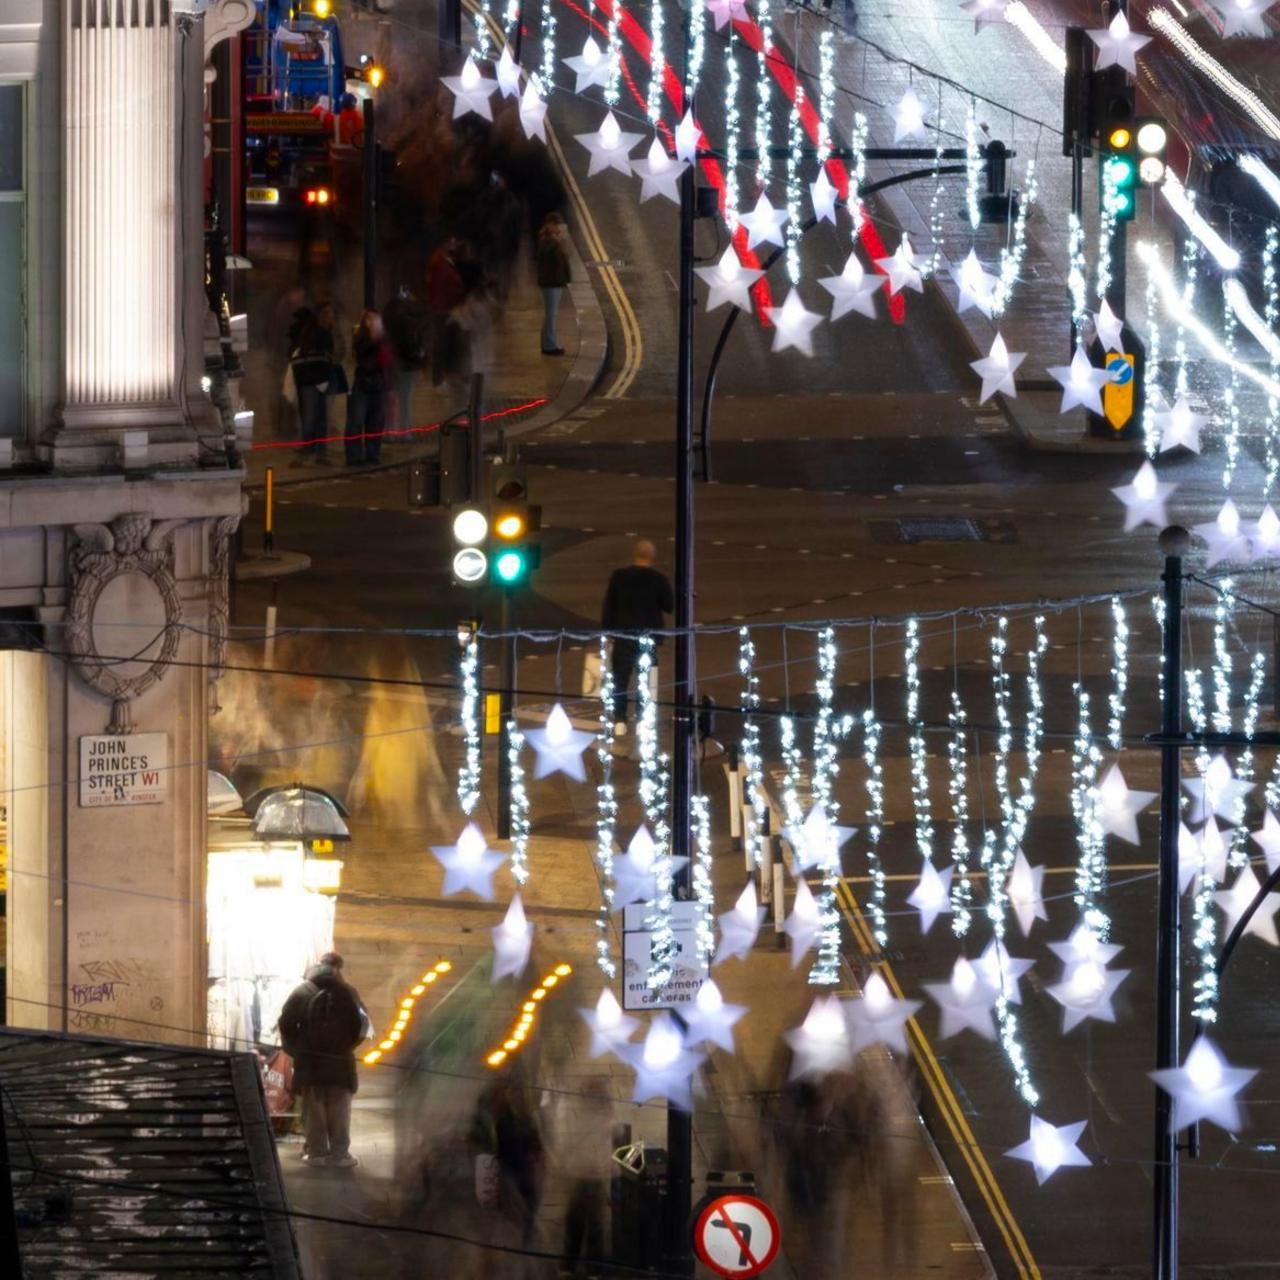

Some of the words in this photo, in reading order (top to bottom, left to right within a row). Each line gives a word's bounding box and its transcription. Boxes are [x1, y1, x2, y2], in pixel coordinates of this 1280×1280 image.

[88, 740, 127, 756] JOHN
[88, 755, 149, 772] PRINCE'S
[88, 772, 138, 789] STREET
[142, 771, 160, 786] W1
[641, 992, 692, 1004] caeras
